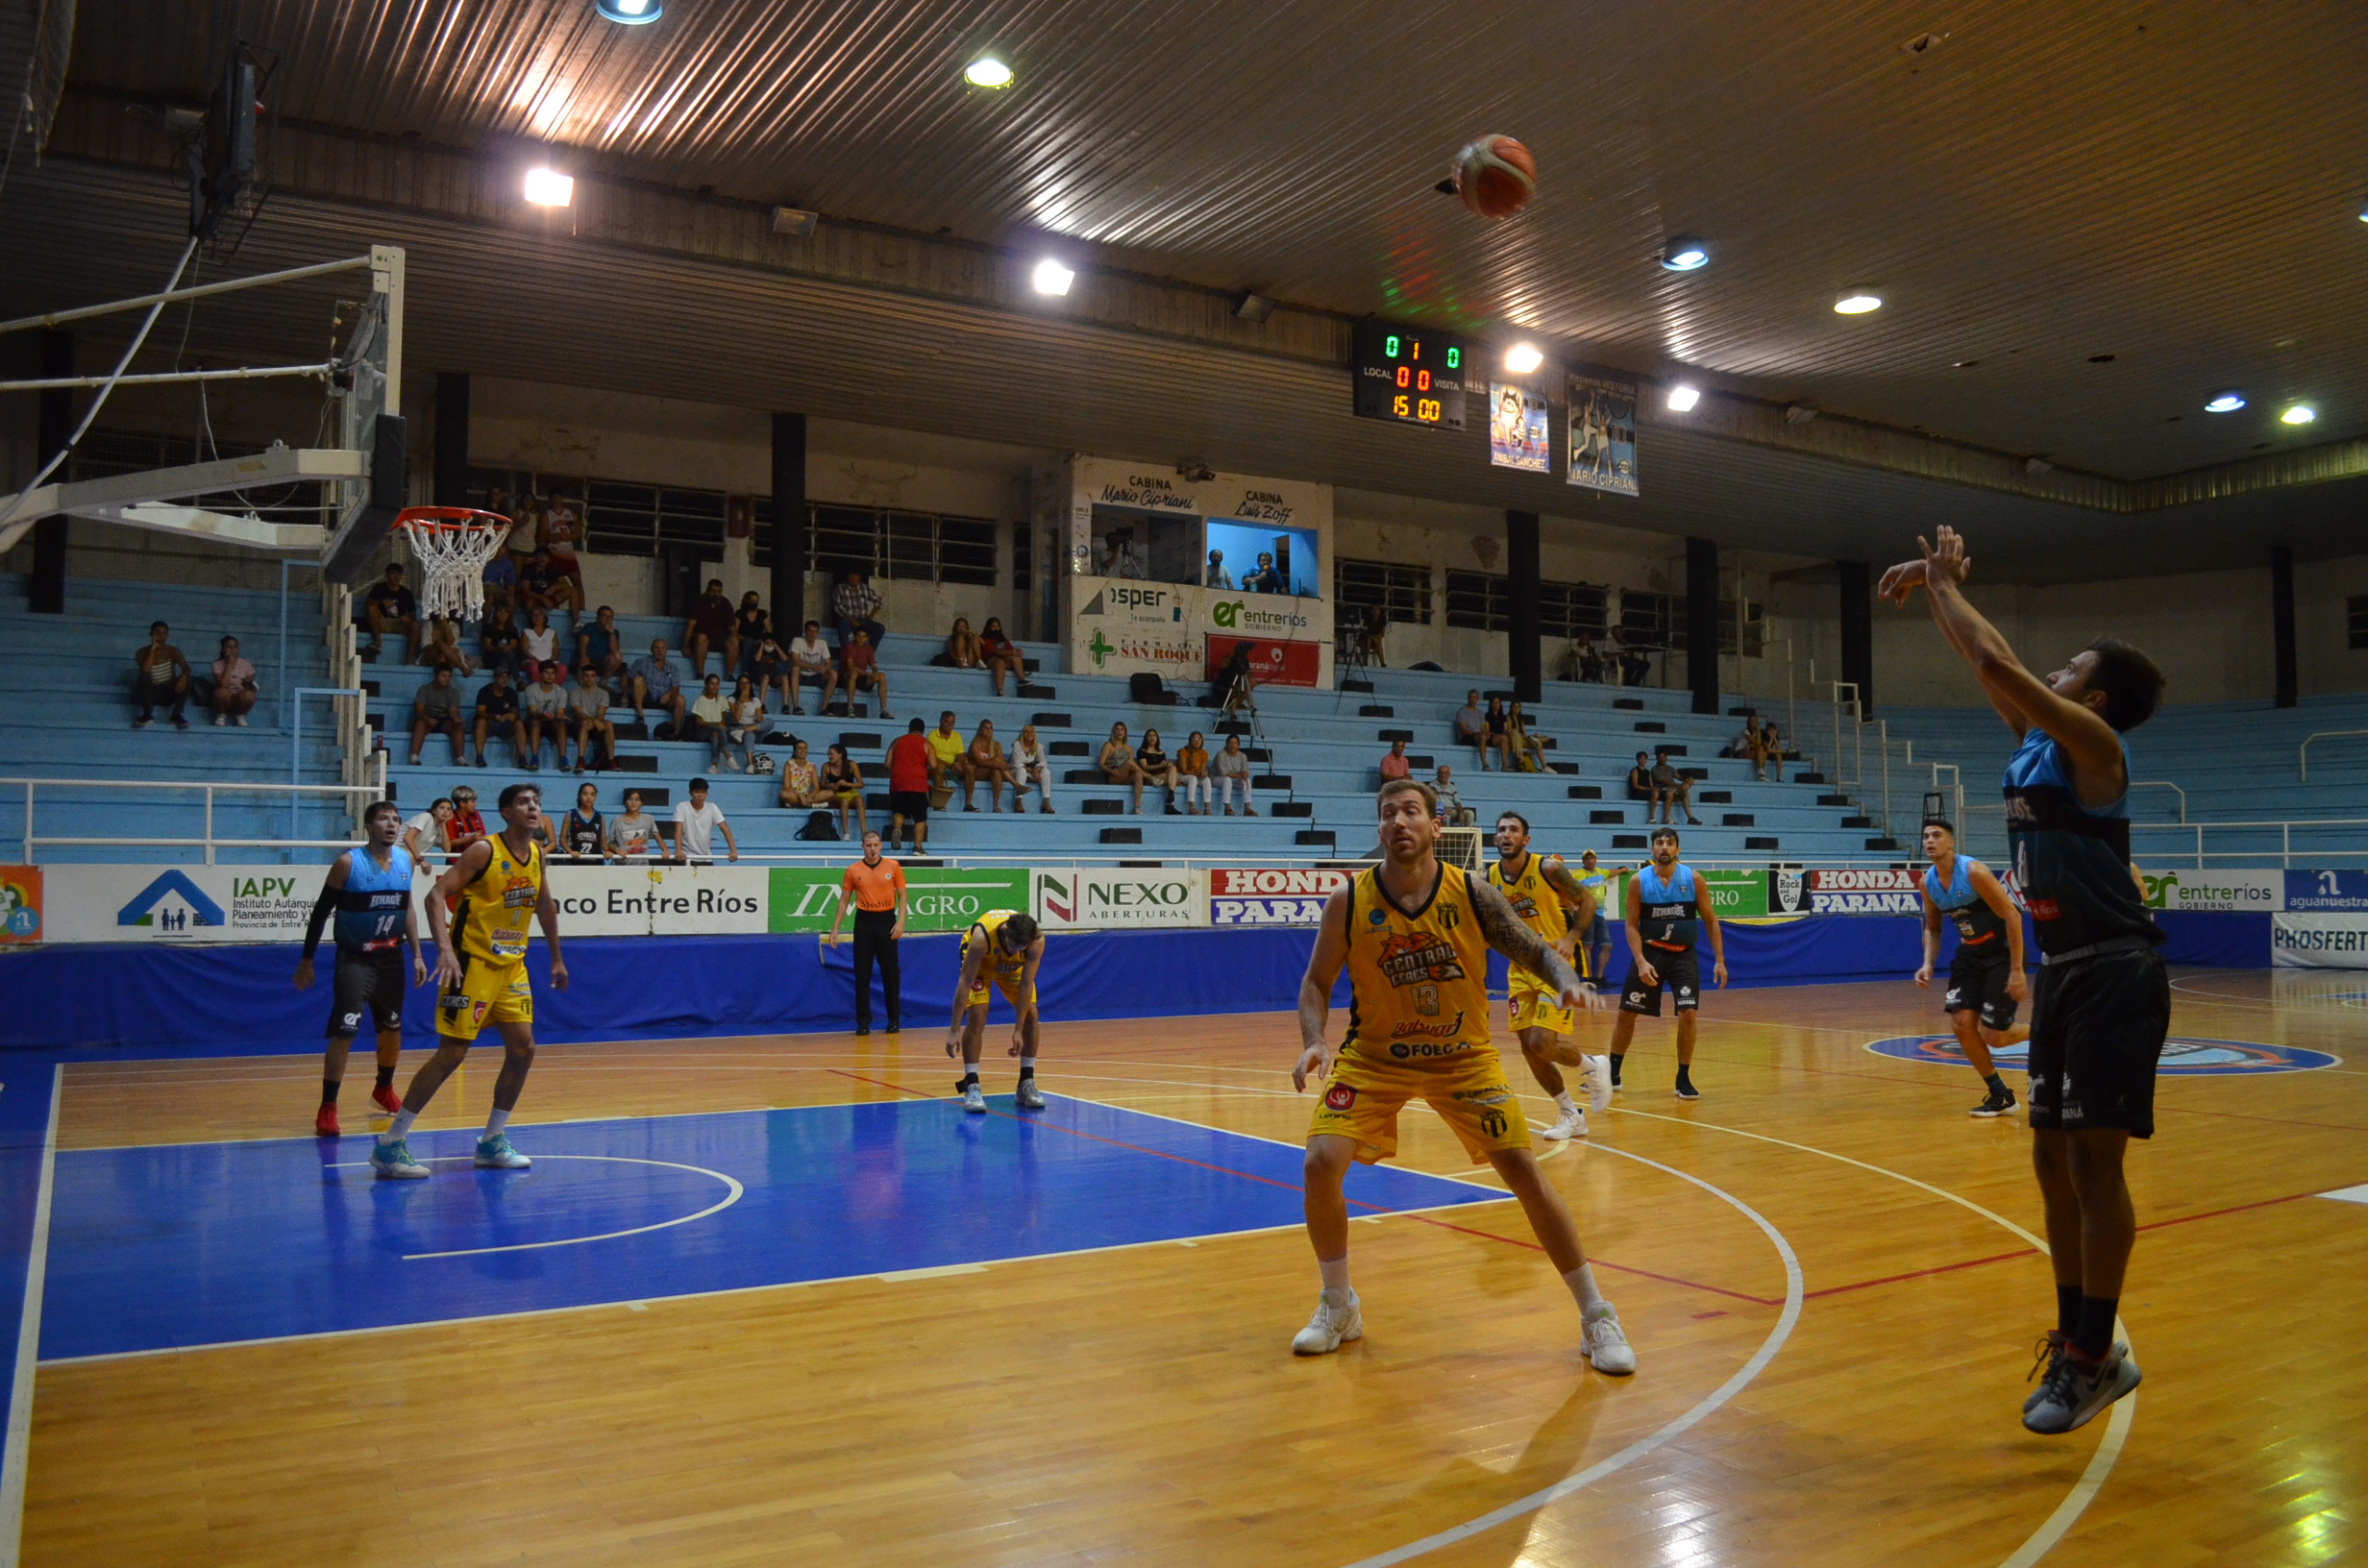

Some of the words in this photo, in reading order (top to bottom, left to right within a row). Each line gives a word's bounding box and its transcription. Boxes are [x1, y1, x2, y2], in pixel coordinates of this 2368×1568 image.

[1386, 336, 1399, 357] 0
[1414, 342, 1419, 360] 1
[1447, 347, 1460, 368] 0
[1364, 367, 1393, 380] LOCAL
[1396, 366, 1410, 388] 0
[1418, 369, 1430, 391] 0
[1434, 379, 1460, 391] VISITA
[1129, 476, 1172, 491] CABINA
[1100, 484, 1140, 503] Mario
[1140, 488, 1195, 509] Cipriani
[1246, 490, 1284, 505] CABINA
[1234, 501, 1262, 519] Luis
[1262, 506, 1294, 525] Zoff
[1244, 610, 1307, 627] entreríos
[1245, 623, 1282, 632] GOBIERNO
[1121, 646, 1149, 658] SAN
[1153, 648, 1202, 663] ROQUE
[234, 877, 296, 897] IAPV
[1225, 870, 1358, 894] HOND
[1780, 879, 1800, 889] Rock
[1817, 870, 1914, 889] HONDA
[1088, 882, 1188, 905] NEXO
[1708, 891, 1739, 906] GRO
[1783, 894, 1797, 904] Gol
[2179, 883, 2272, 900] entreríos
[233, 898, 271, 909] Instituto
[274, 898, 317, 911] Autárqui
[552, 897, 597, 914] nco
[607, 889, 689, 914] Entre
[697, 889, 757, 914] Ríos
[1812, 894, 1921, 914] PARANA
[2179, 901, 2233, 910] GOBIERNO
[2290, 896, 2368, 909] aguanuestra
[233, 909, 298, 919] Planeamiento
[301, 911, 308, 921] y
[1089, 909, 1188, 919] ABERTURAS
[1216, 900, 1321, 923] PARA
[233, 919, 266, 928] Provincia
[282, 919, 301, 928] Entre
[1383, 943, 1457, 975] CENTRAL
[1392, 967, 1429, 986] CERES
[1411, 985, 1440, 1017] 13
